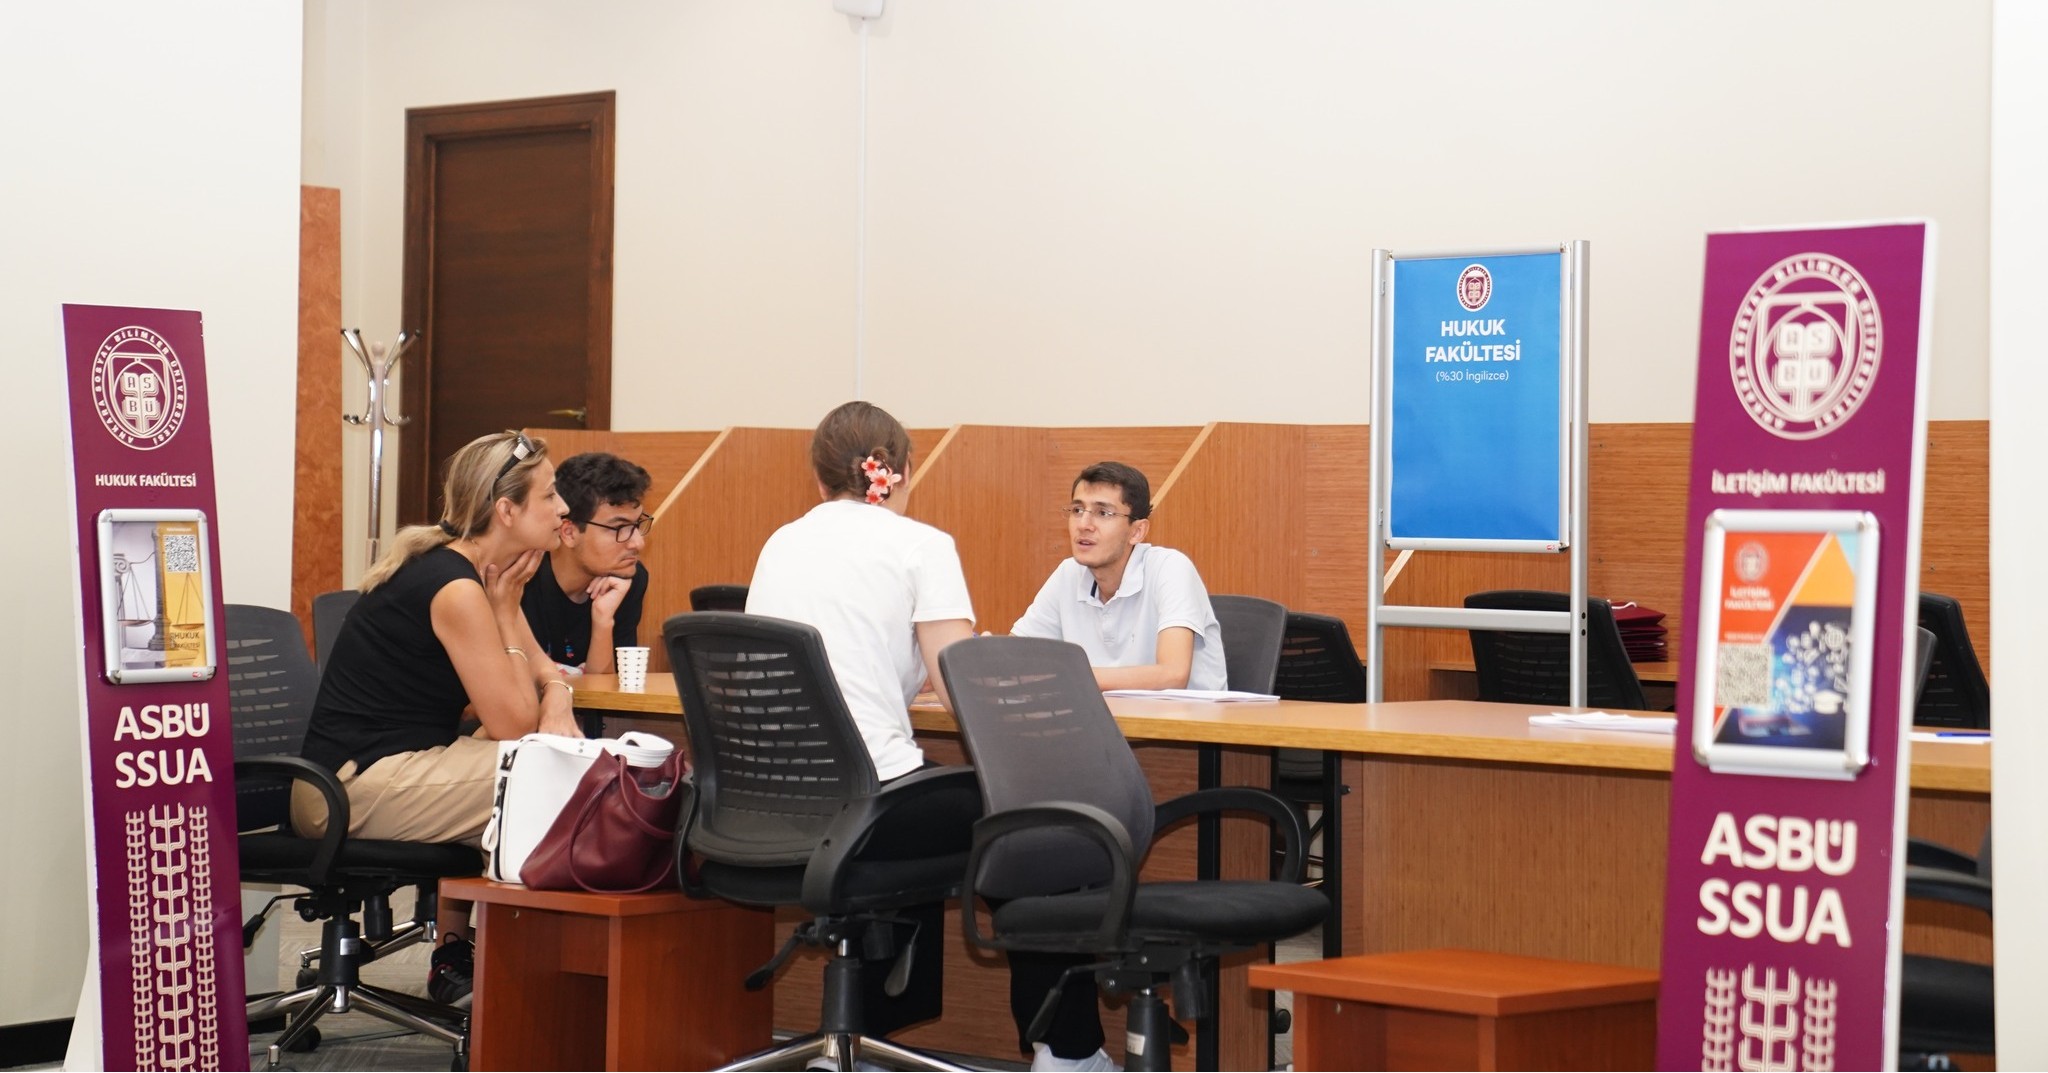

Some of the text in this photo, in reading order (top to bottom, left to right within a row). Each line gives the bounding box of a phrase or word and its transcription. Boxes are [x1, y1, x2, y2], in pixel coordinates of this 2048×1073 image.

[1441, 318, 1505, 337] HUKUK
[1425, 339, 1521, 363] FAKÜLTESİ
[94, 328, 185, 446] ANKARA SOSYAL BİLİMLER ÜNİVERSİTESİ
[1435, 368, 1510, 384] (%30 İngilizce)
[95, 471, 197, 488] HUKUK FAKÜLTESİ
[1711, 467, 1886, 498] İLETİŞİM FAKÜLTESİ
[113, 702, 210, 742] ASBÜ
[114, 747, 213, 789] SSUA
[1699, 811, 1859, 877] ASBÜ
[1696, 877, 1854, 949] SSUA
